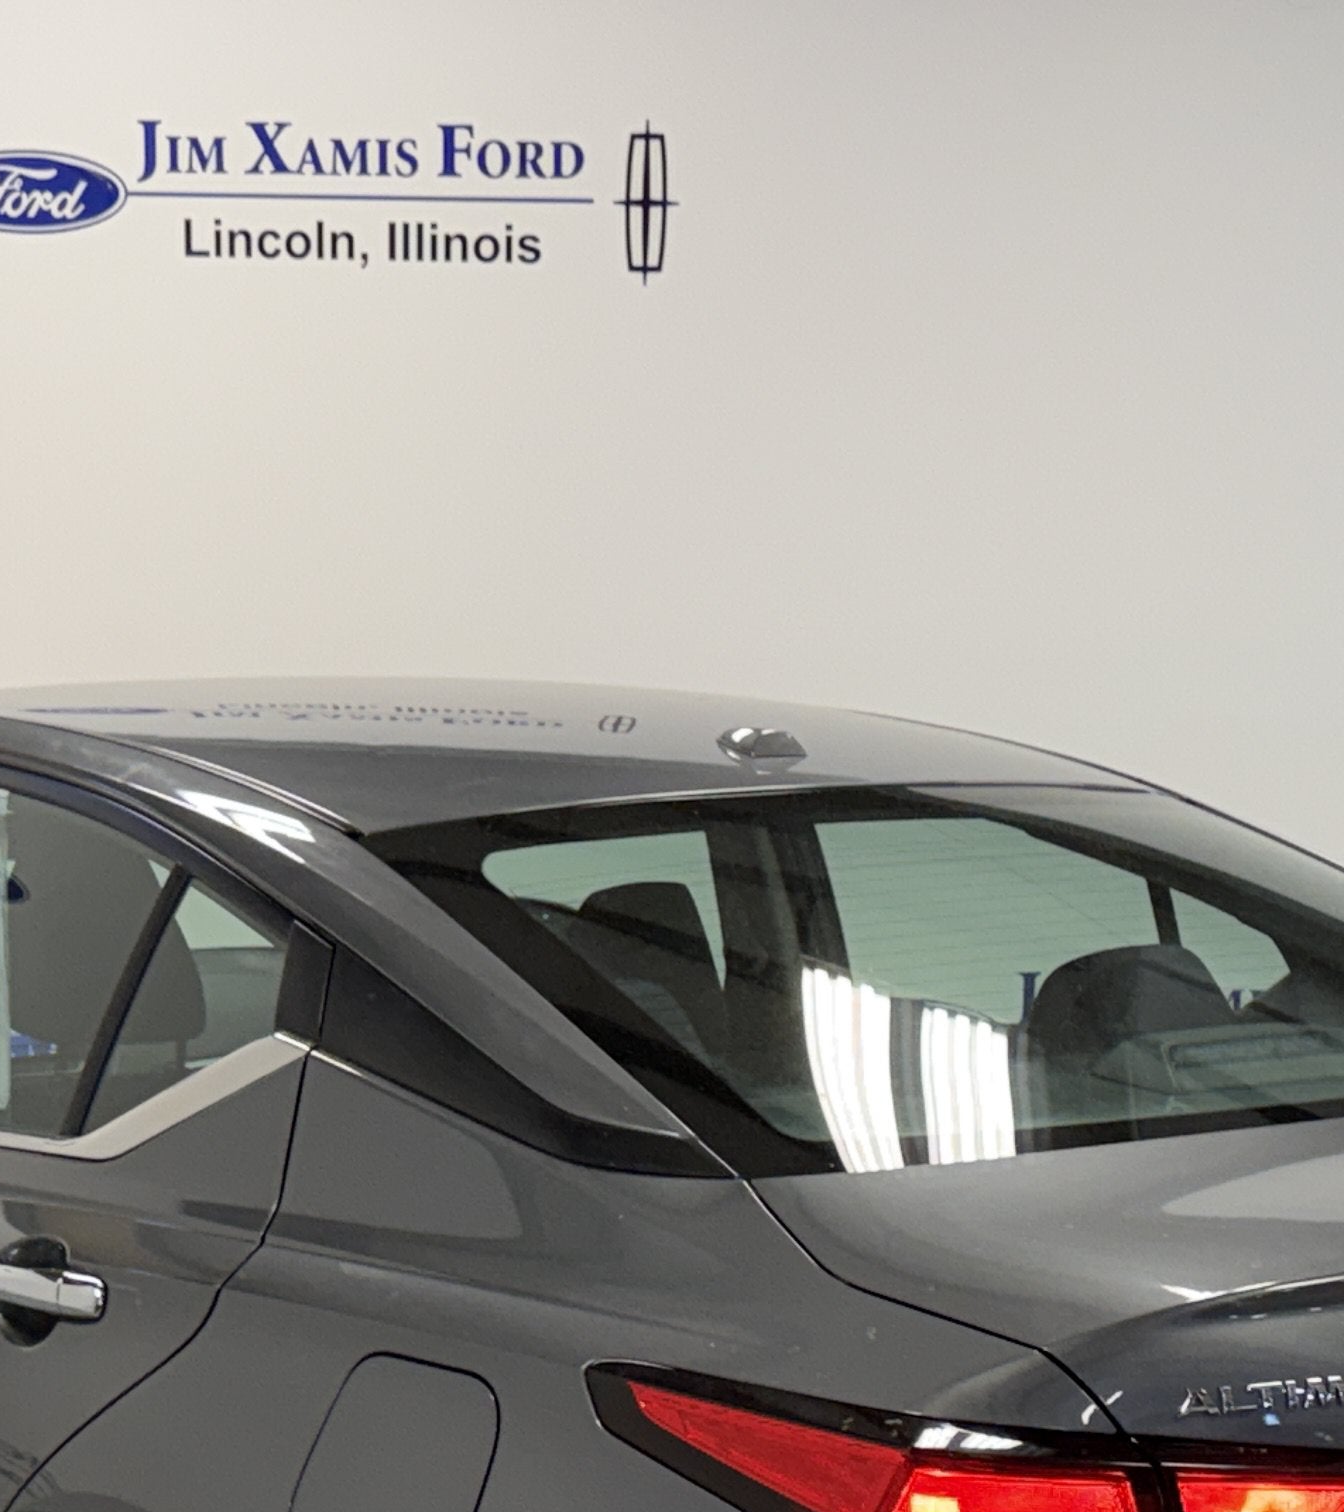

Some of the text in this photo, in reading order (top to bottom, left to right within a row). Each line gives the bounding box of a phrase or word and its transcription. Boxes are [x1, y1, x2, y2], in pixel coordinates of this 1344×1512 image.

[136, 119, 585, 183] JIM XAMIS FORD
[183, 218, 543, 268] Lincoln, Illinois
